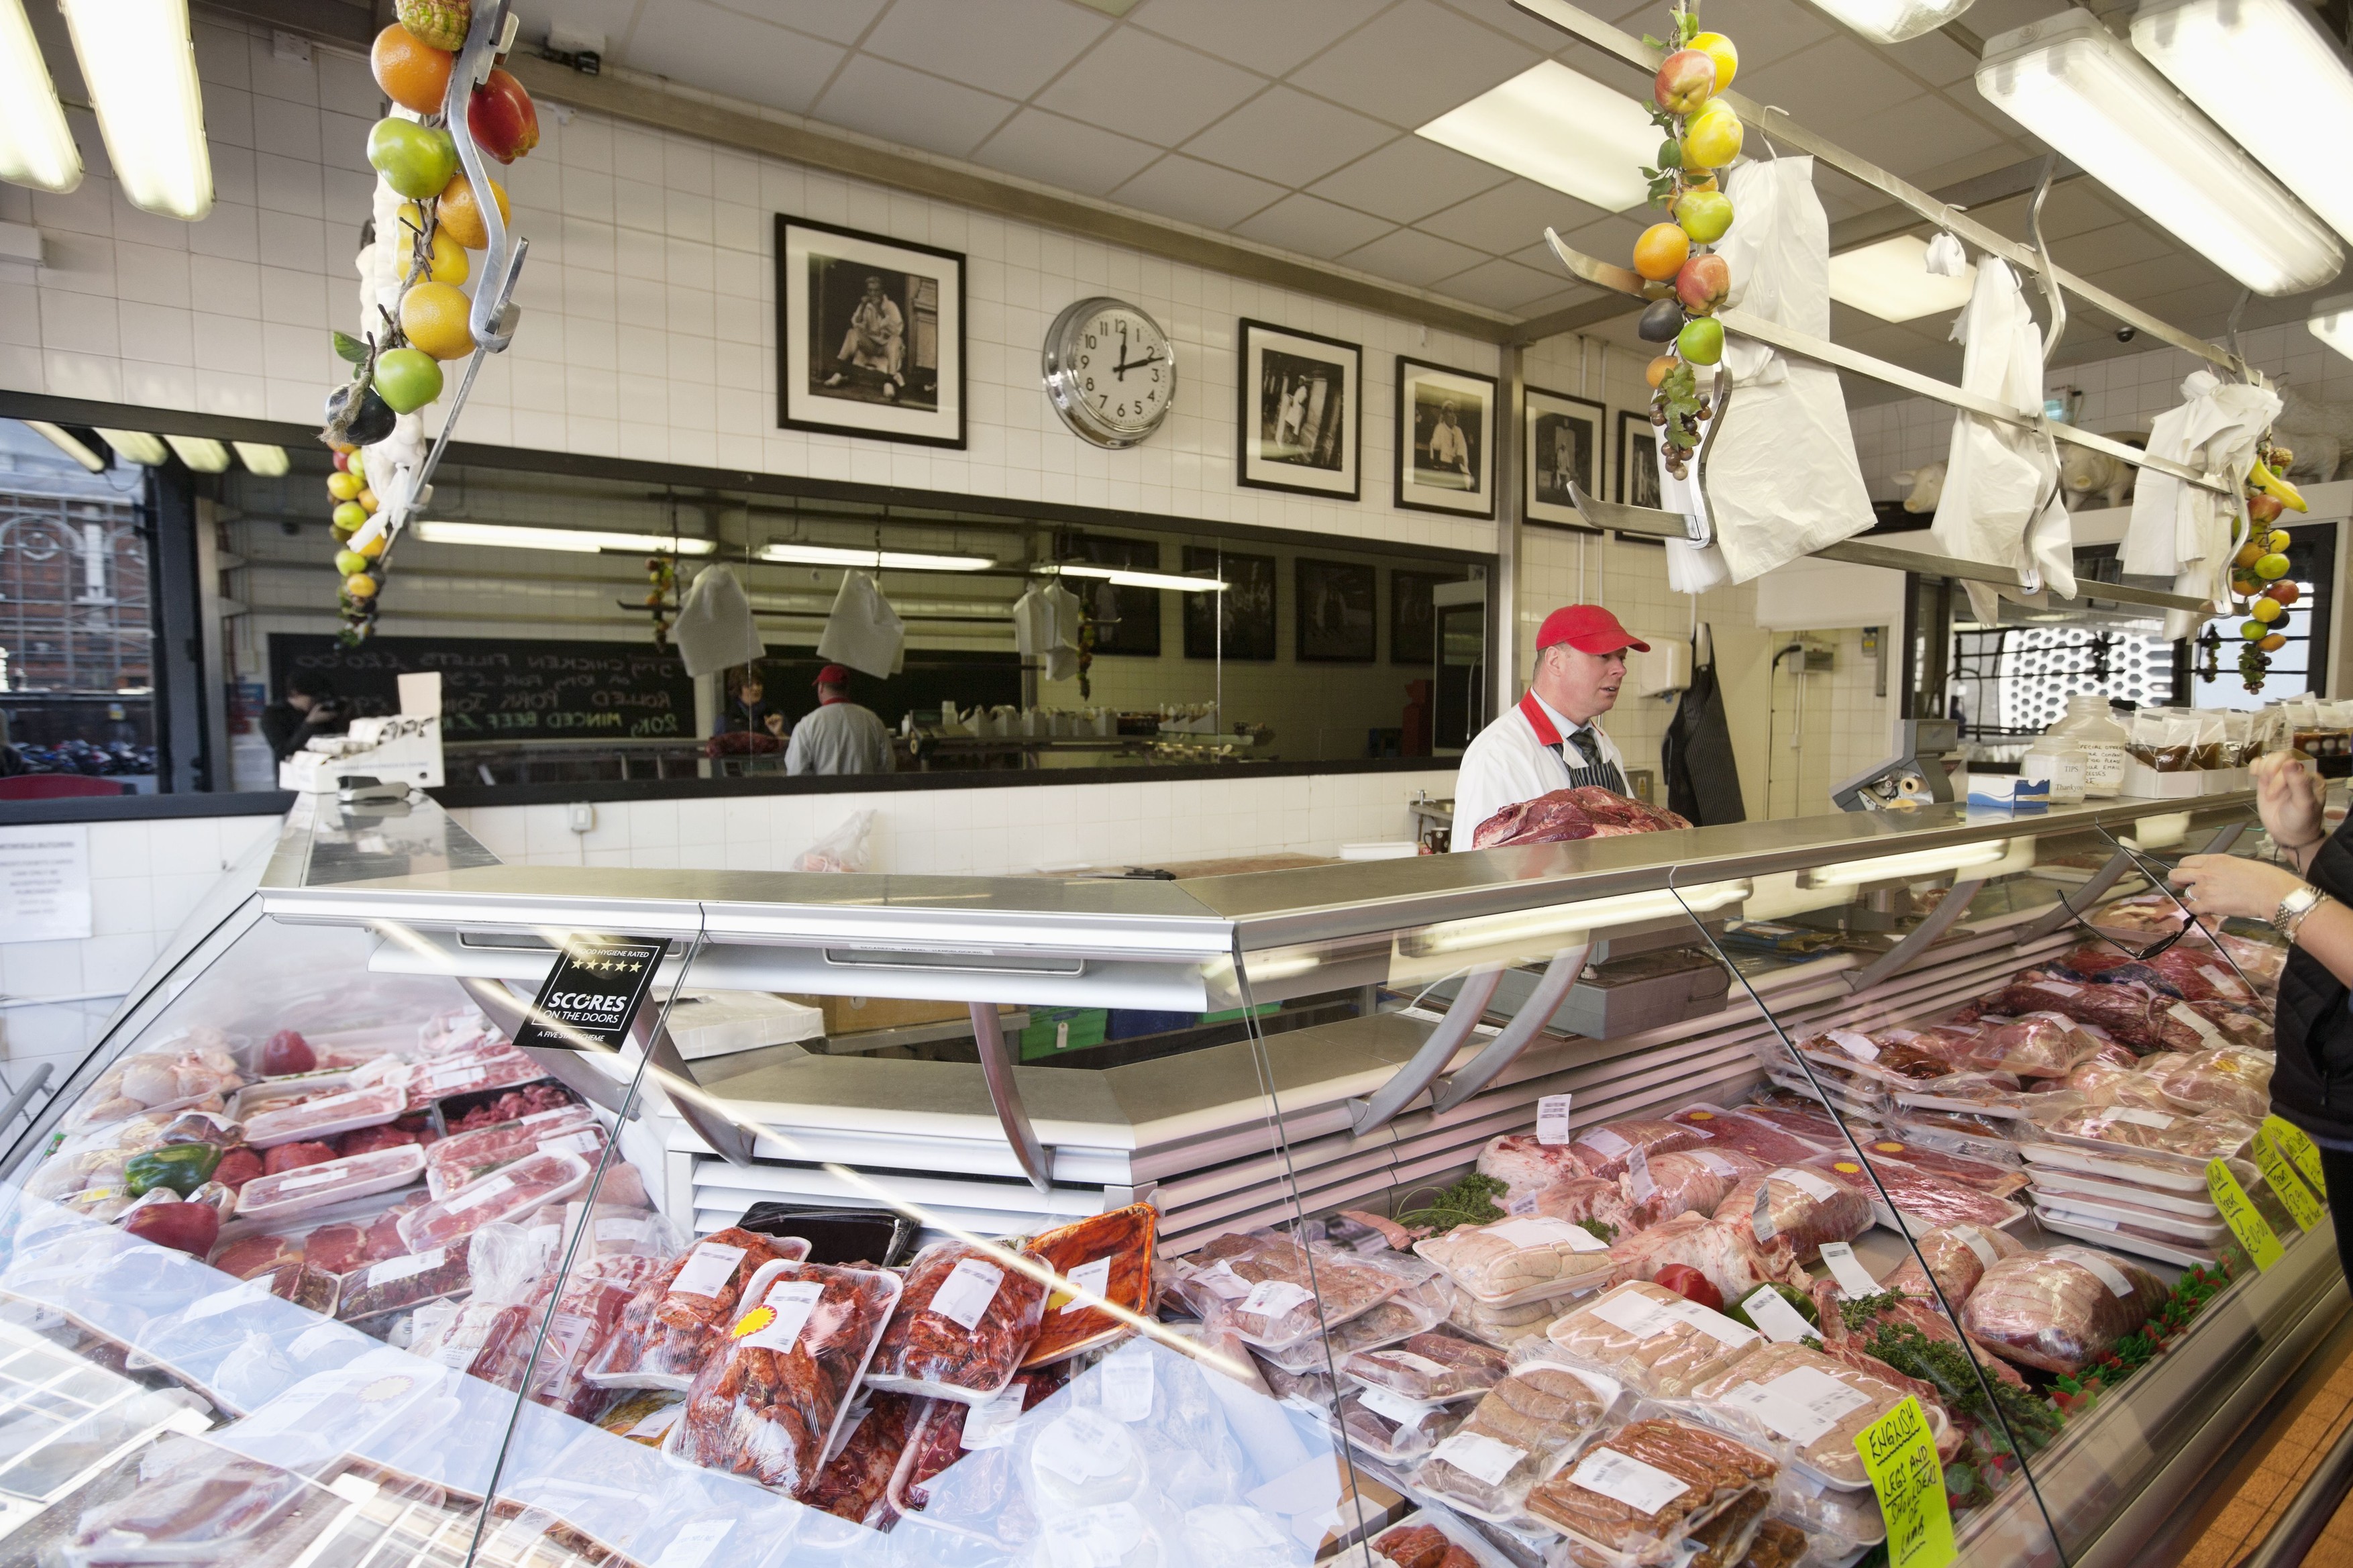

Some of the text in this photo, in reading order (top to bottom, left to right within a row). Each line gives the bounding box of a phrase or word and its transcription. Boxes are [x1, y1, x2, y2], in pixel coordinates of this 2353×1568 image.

[1100, 321, 1108, 336] 11
[1114, 318, 1127, 335] 12
[1085, 333, 1097, 350] 10
[1136, 328, 1140, 343] 1
[1146, 346, 1155, 361] 2
[1081, 355, 1090, 369] 9
[1151, 368, 1159, 382] 3
[1086, 377, 1094, 391] 8
[1099, 395, 1108, 409] 7
[1147, 389, 1155, 402] 4
[1116, 403, 1126, 417] 6
[1134, 401, 1143, 415] 5
[2056, 784, 2083, 792] Thankyou
[597, 949, 627, 957] HYGIENE
[627, 950, 649, 958] RATED
[547, 991, 628, 1012] SCORES
[543, 1009, 620, 1023] ON THE DOORS
[577, 1033, 605, 1042] SCHEME
[1869, 1402, 1916, 1460] ENGLISH
[1882, 1444, 1929, 1502] LEGS AND
[1891, 1464, 1938, 1526] SHOULDERS
[1907, 1500, 1921, 1524] OF
[1899, 1514, 1925, 1561] LAMB
